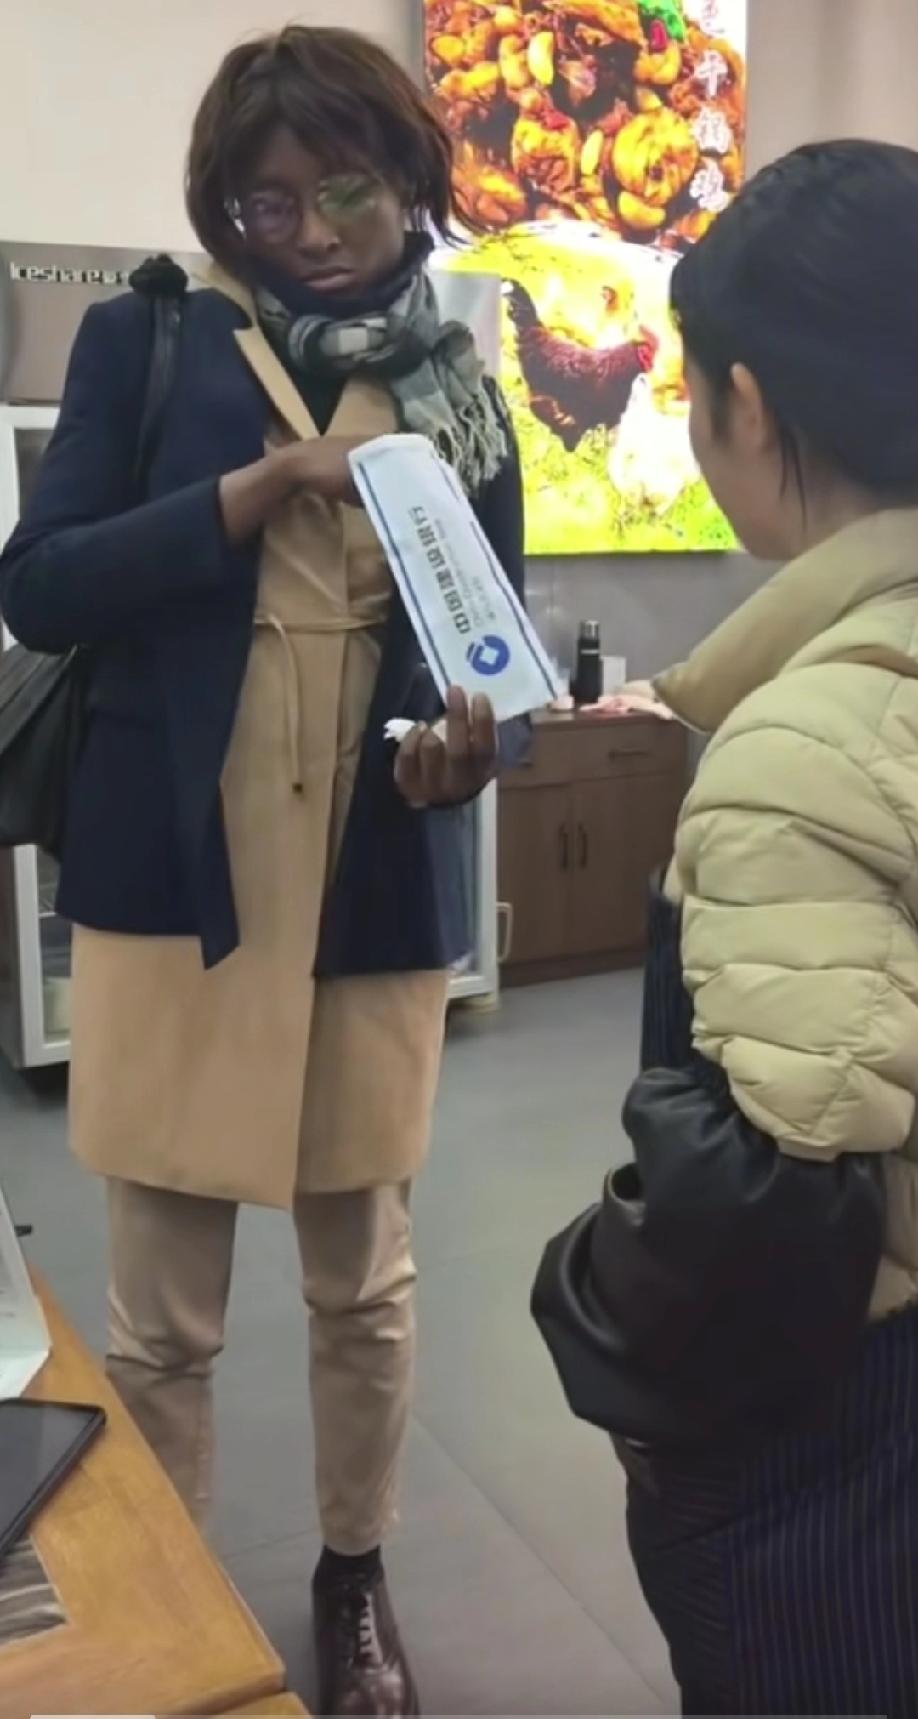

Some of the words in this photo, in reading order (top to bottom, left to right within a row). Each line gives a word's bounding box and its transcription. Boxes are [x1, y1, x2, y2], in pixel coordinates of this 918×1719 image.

[408, 505, 471, 634] 中国建设银行
